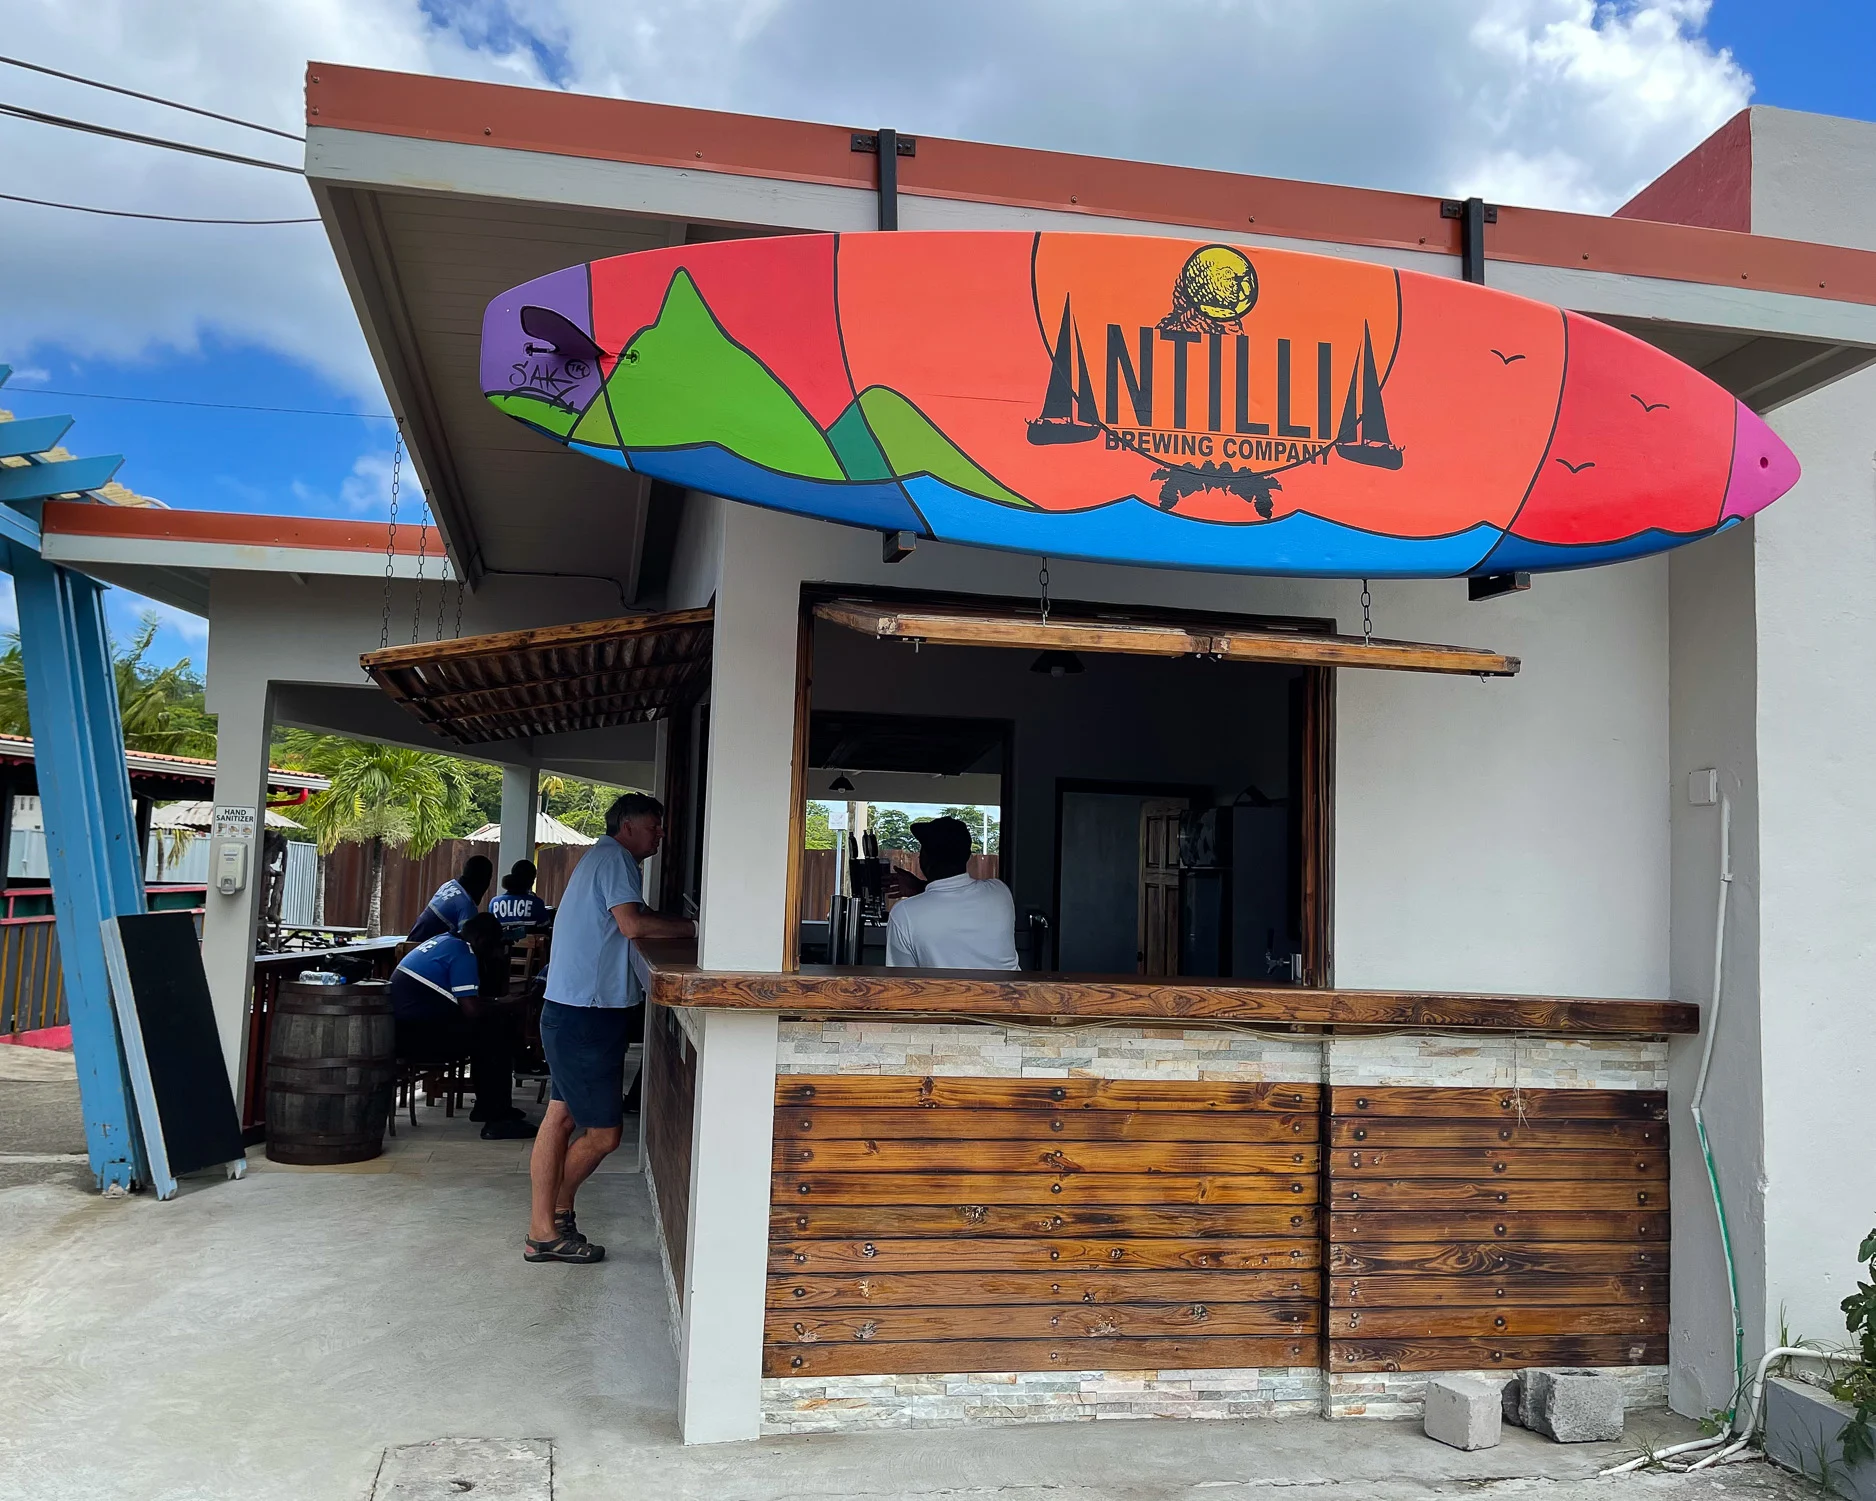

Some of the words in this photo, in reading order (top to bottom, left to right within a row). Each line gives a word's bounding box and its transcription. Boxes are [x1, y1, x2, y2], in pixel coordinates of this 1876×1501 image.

[1105, 430, 1214, 457] BREWING
[1223, 438, 1332, 466] COMPANY
[216, 814, 254, 823] SANITIZER
[224, 808, 247, 816] HAND
[493, 899, 533, 918] POLICE
